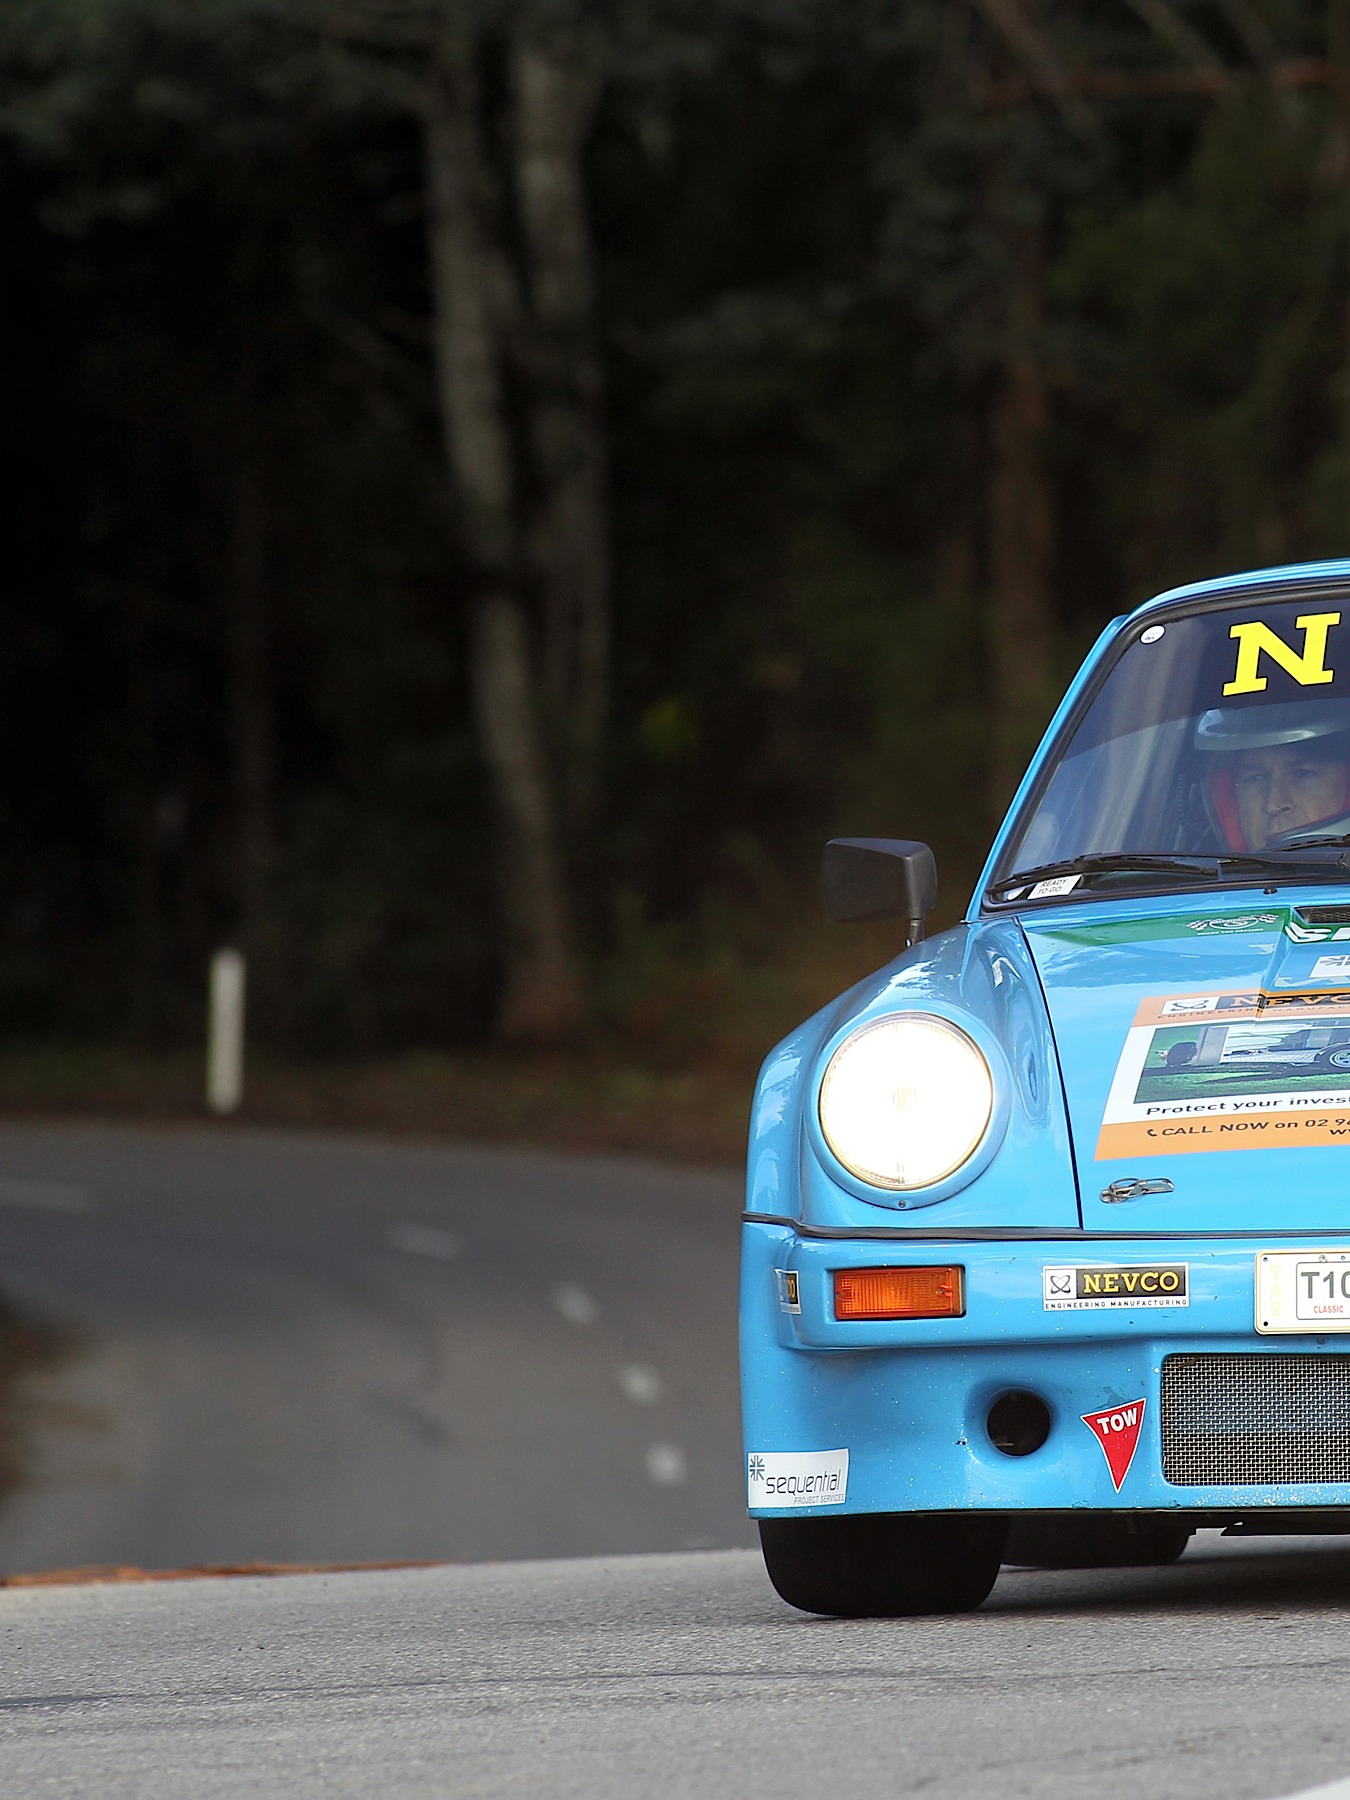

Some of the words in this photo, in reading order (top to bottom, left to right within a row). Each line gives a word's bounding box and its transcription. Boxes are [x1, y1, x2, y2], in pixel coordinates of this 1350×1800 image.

[1040, 878, 1069, 888] READY
[1157, 1008, 1260, 1019] ENGINEERIN
[1146, 1103, 1226, 1115] Protect
[1233, 1099, 1284, 1111] your
[1161, 1123, 1213, 1136] CALL
[1219, 1121, 1270, 1132] NOW
[1275, 1121, 1299, 1129] on
[1305, 1117, 1329, 1128] 02
[1083, 1271, 1179, 1294] NEVCO
[1045, 1301, 1106, 1310] ENGINEERING
[1110, 1299, 1188, 1307] MANUFACTURING
[1313, 1305, 1345, 1315] CLASSIC
[1096, 1407, 1137, 1434] TOW
[765, 1468, 842, 1496] sequential
[793, 1495, 819, 1505] PROJECT
[820, 1493, 845, 1503] SERVICES
